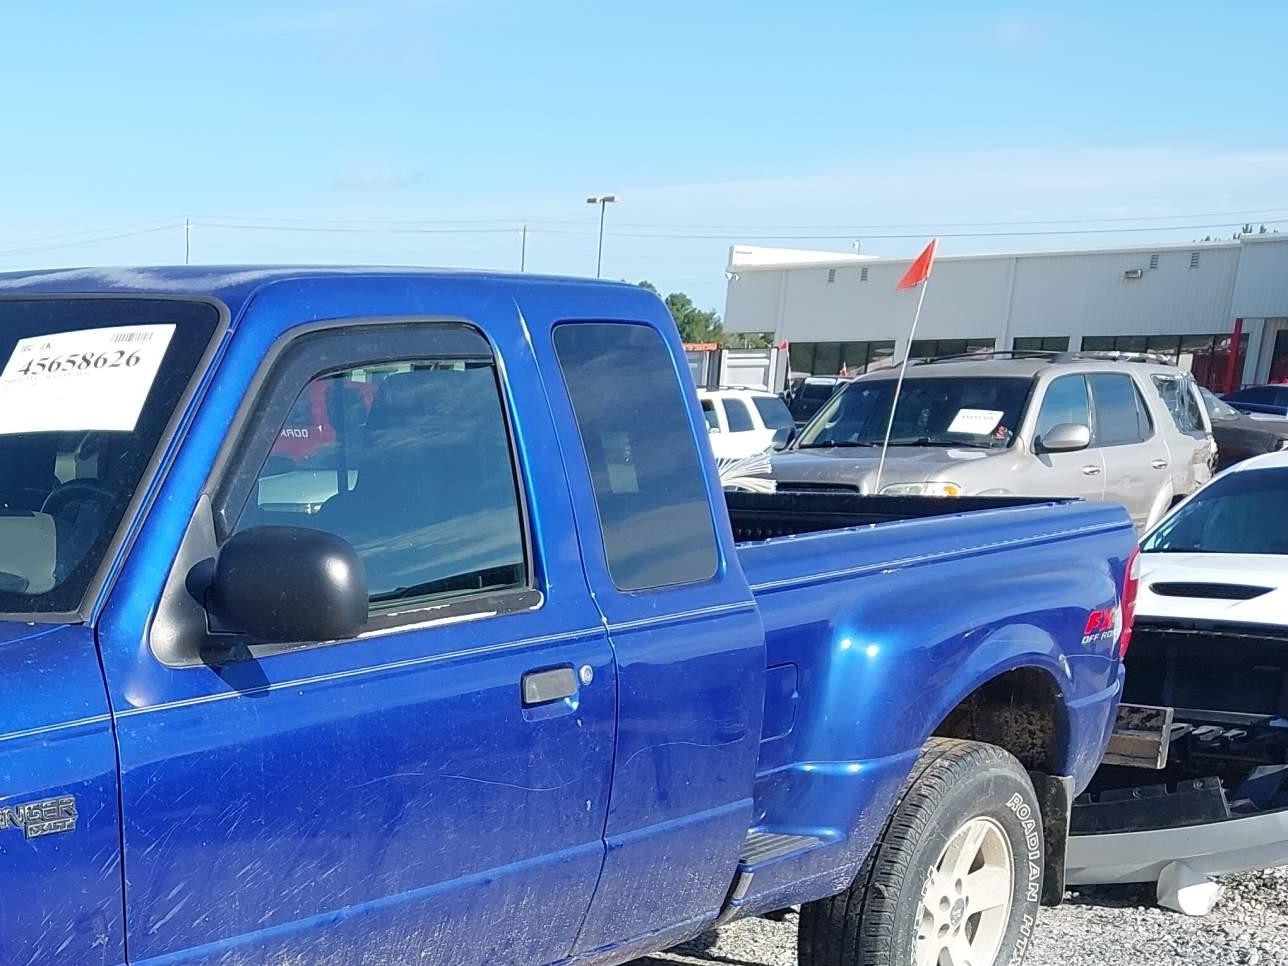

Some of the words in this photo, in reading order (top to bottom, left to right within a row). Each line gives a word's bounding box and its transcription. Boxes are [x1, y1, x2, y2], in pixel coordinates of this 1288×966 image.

[17, 350, 142, 375] 45658626
[1081, 634, 1100, 644] OFF
[1006, 792, 1040, 902] ROADIAN
